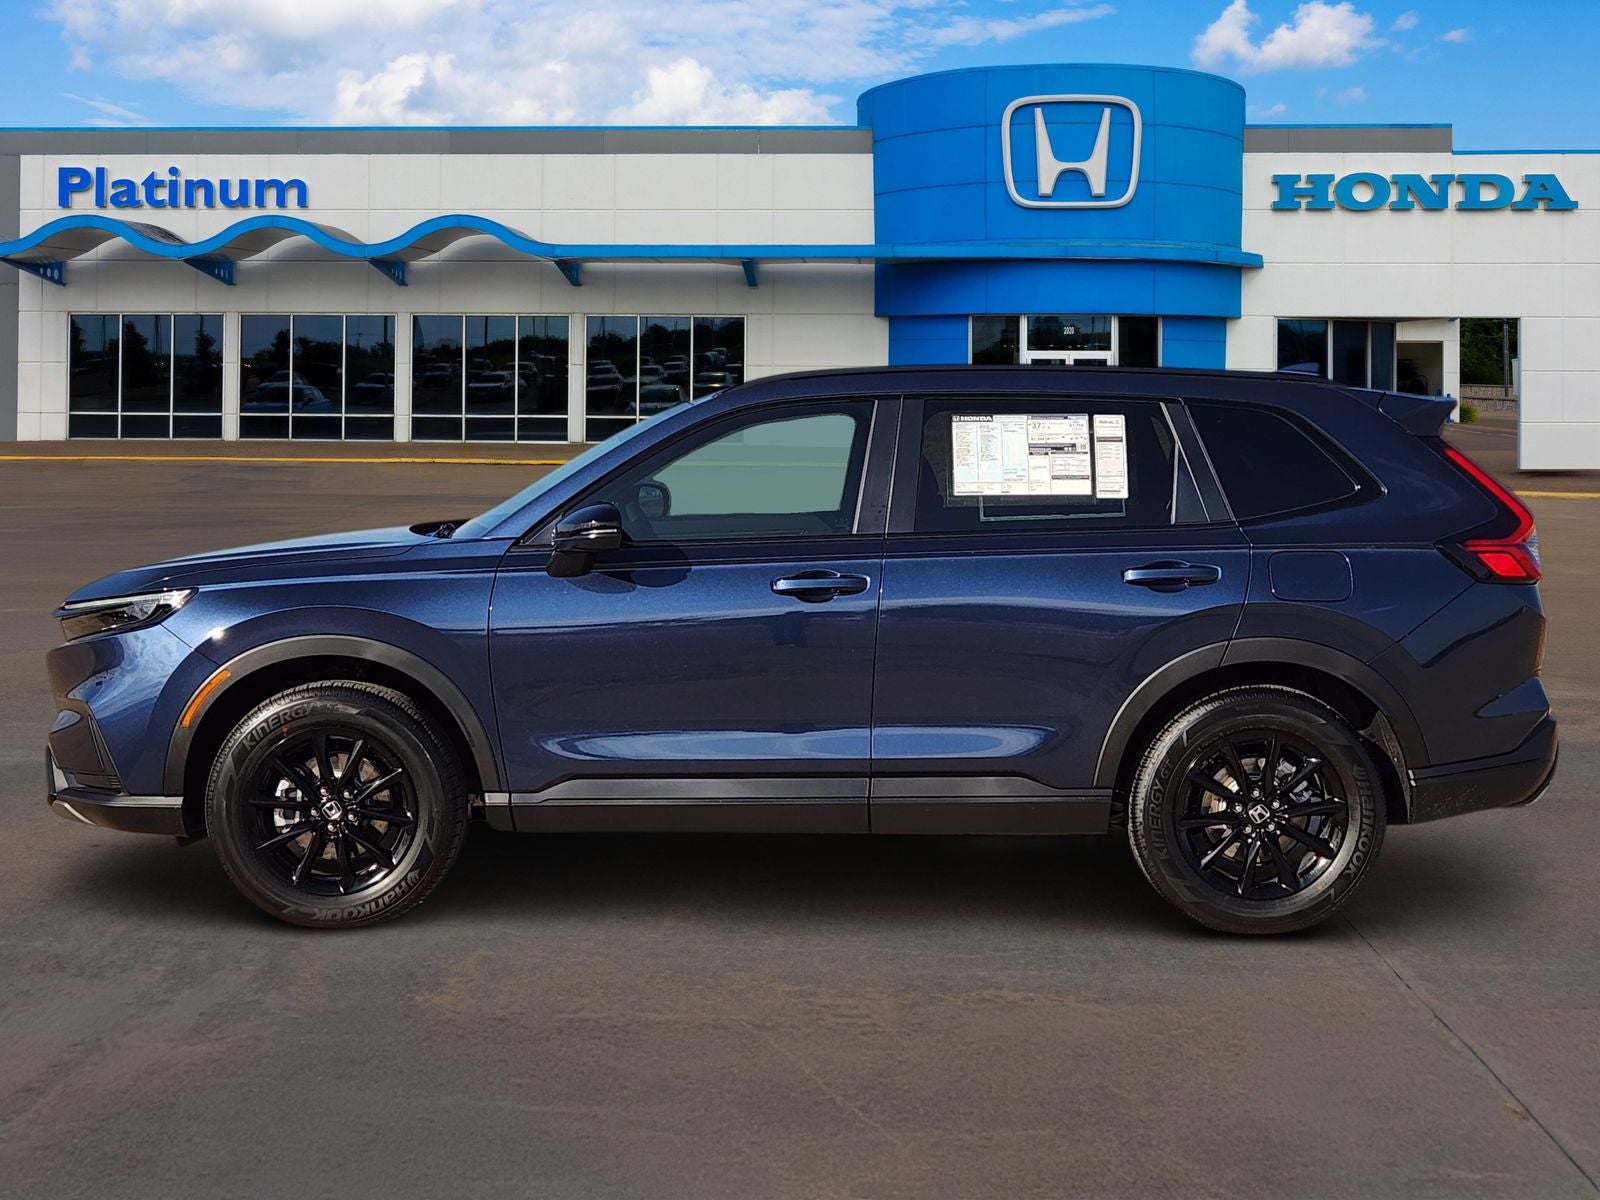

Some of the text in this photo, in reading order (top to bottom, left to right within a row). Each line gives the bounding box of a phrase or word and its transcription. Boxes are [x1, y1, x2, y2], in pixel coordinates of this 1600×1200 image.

[58, 166, 308, 208] Platinum
[1272, 172, 1578, 212] HONDA
[1063, 326, 1075, 335] 2020
